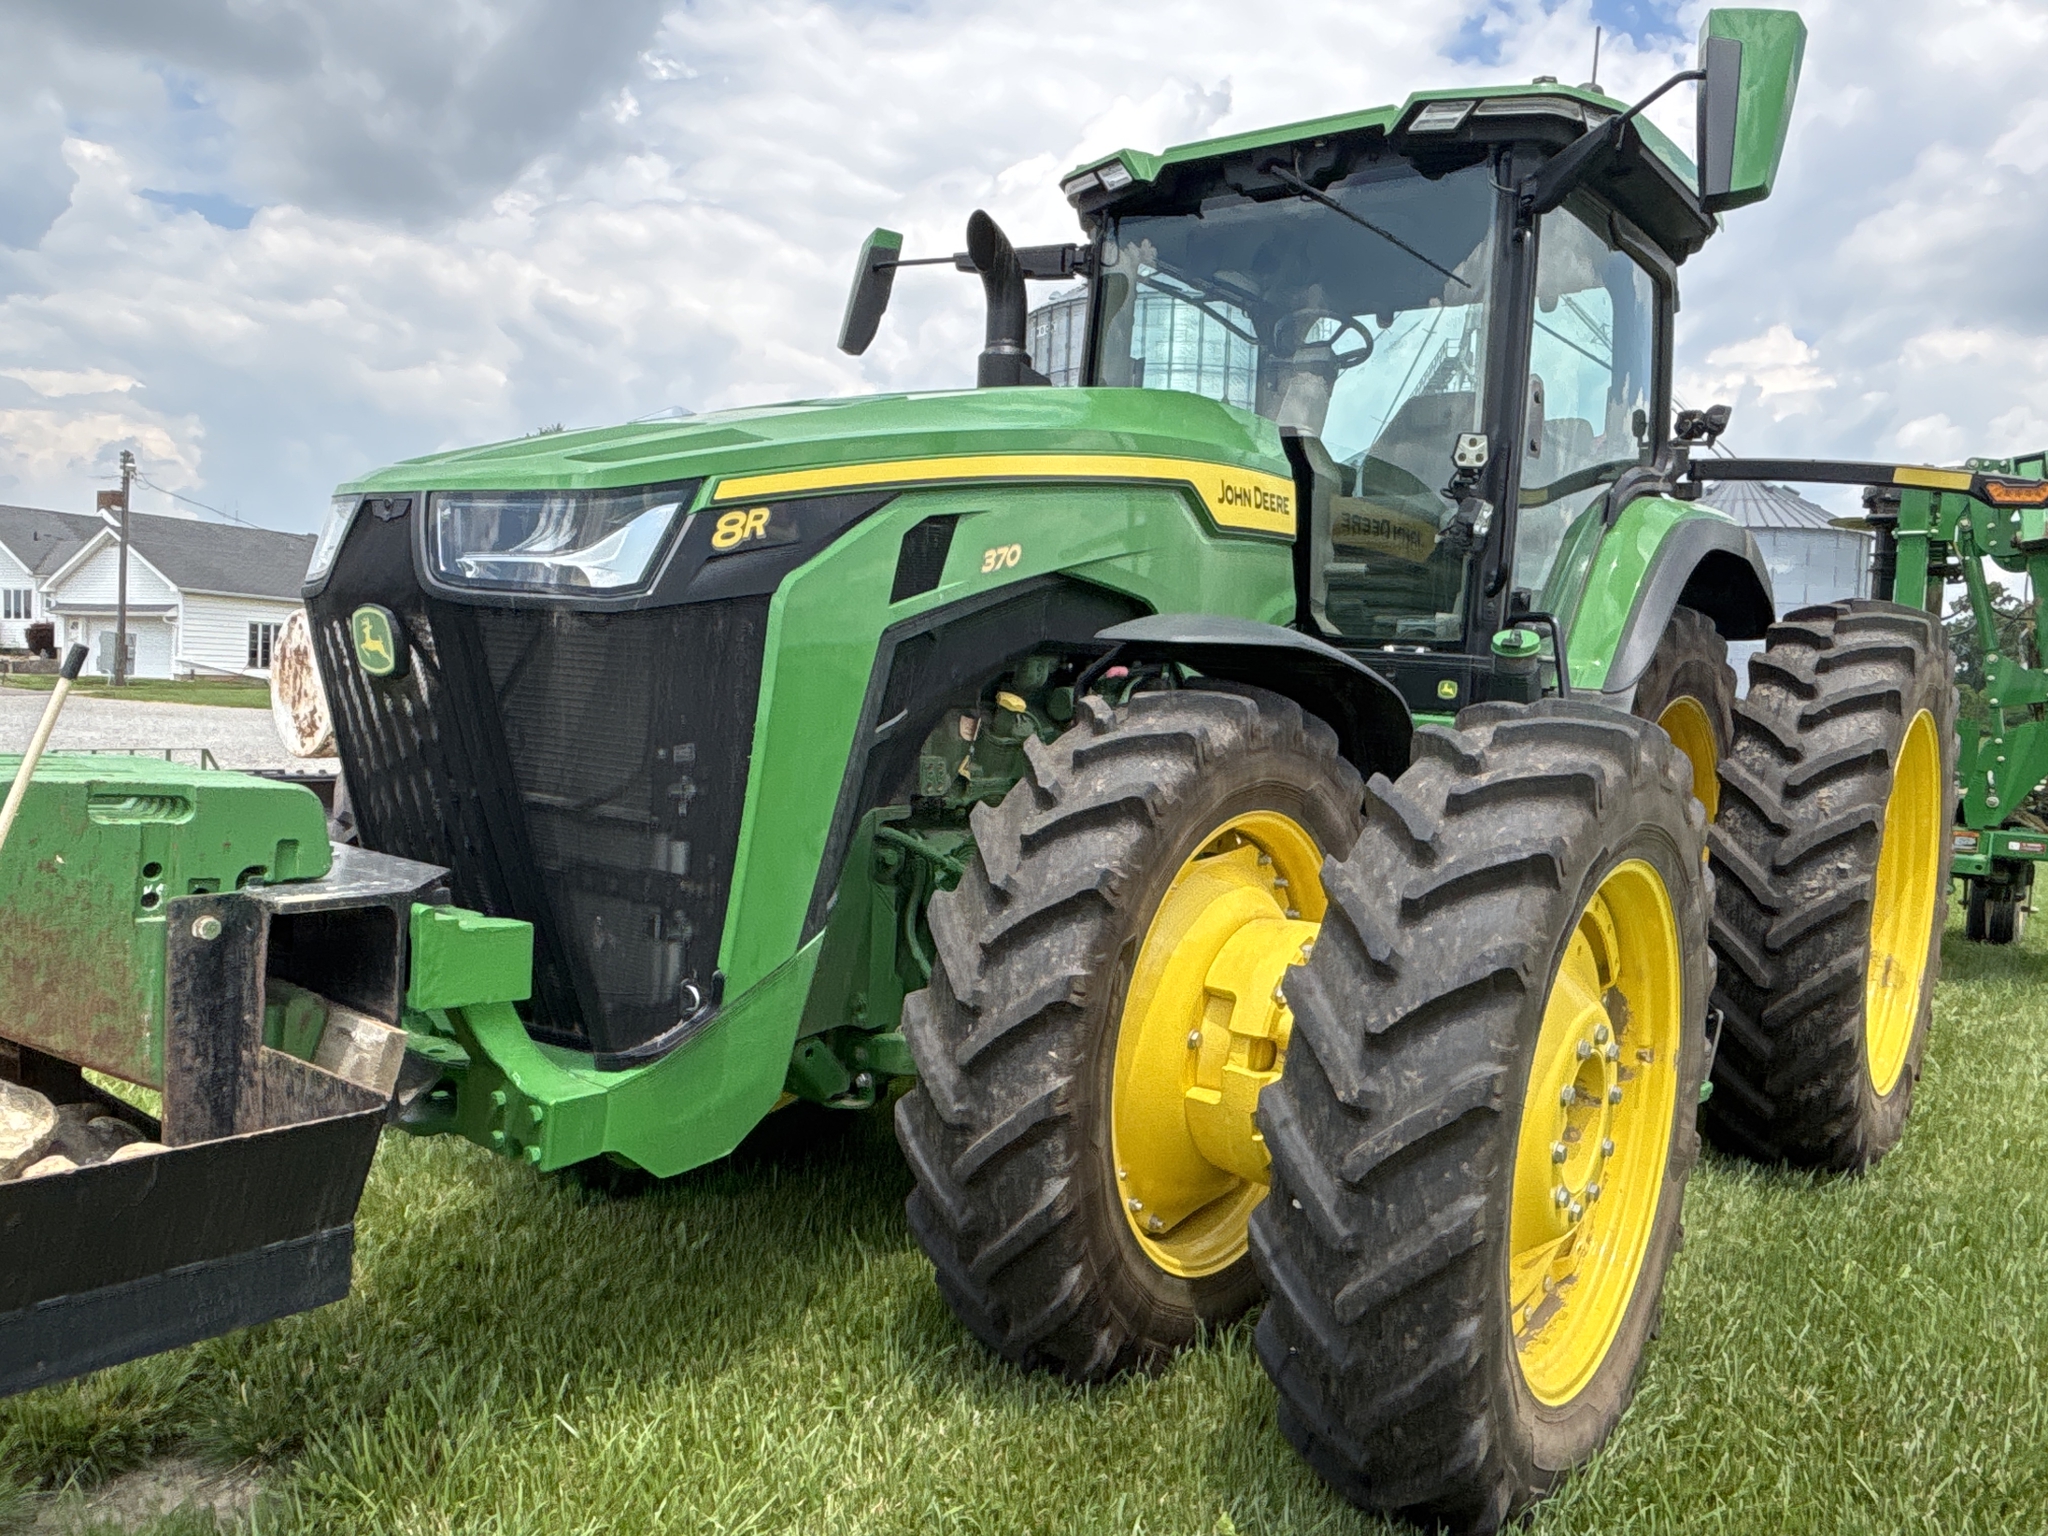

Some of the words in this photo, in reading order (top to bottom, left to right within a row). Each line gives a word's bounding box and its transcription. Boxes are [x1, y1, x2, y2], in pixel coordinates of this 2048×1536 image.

[1218, 479, 1252, 508] JOHN
[1253, 485, 1290, 516] DEERE
[711, 506, 771, 551] 8R
[980, 543, 1022, 574] 370
